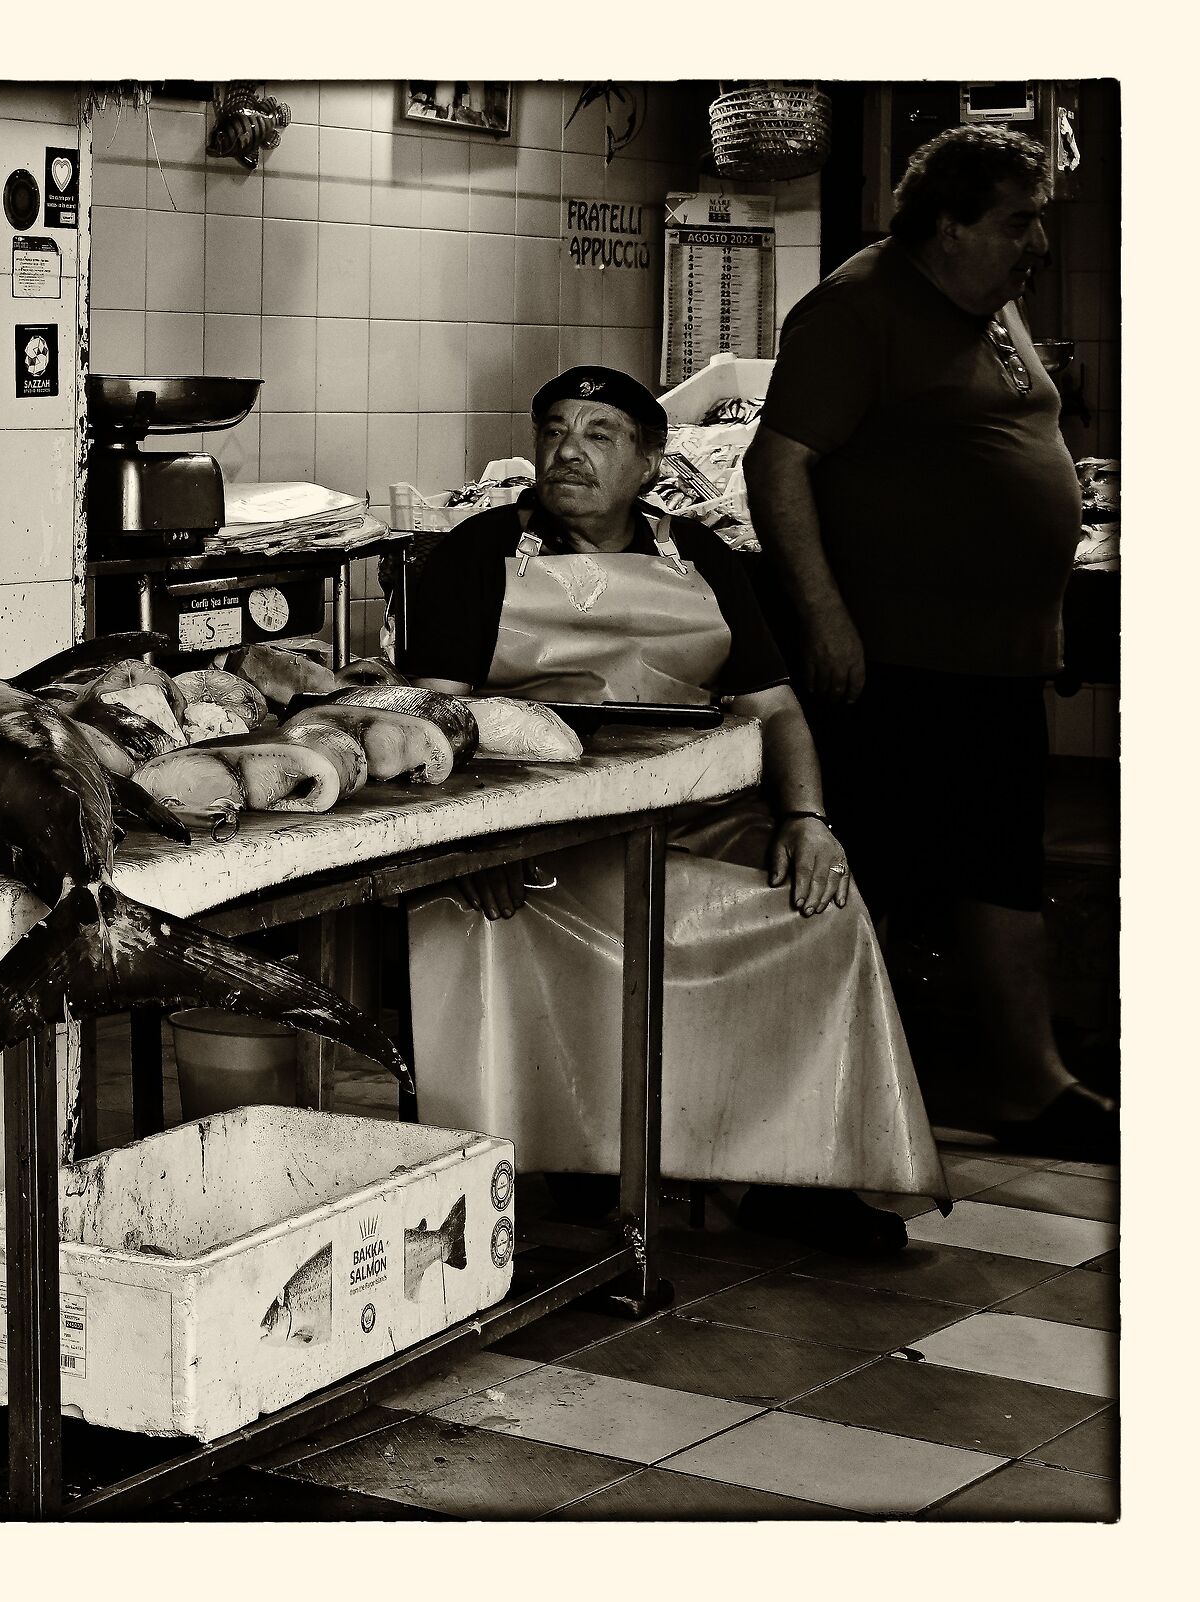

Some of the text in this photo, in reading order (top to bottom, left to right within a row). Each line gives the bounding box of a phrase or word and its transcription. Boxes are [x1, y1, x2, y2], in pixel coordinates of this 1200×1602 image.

[568, 200, 642, 234] FRATELLI
[688, 234, 754, 244] AGOSTO 2024
[24, 380, 50, 388] SAZZAH
[211, 597, 222, 608] Sea
[223, 596, 239, 605] Farm
[206, 617, 215, 639] S
[353, 1239, 384, 1266] BAKKA
[350, 1256, 387, 1286] SALMON
